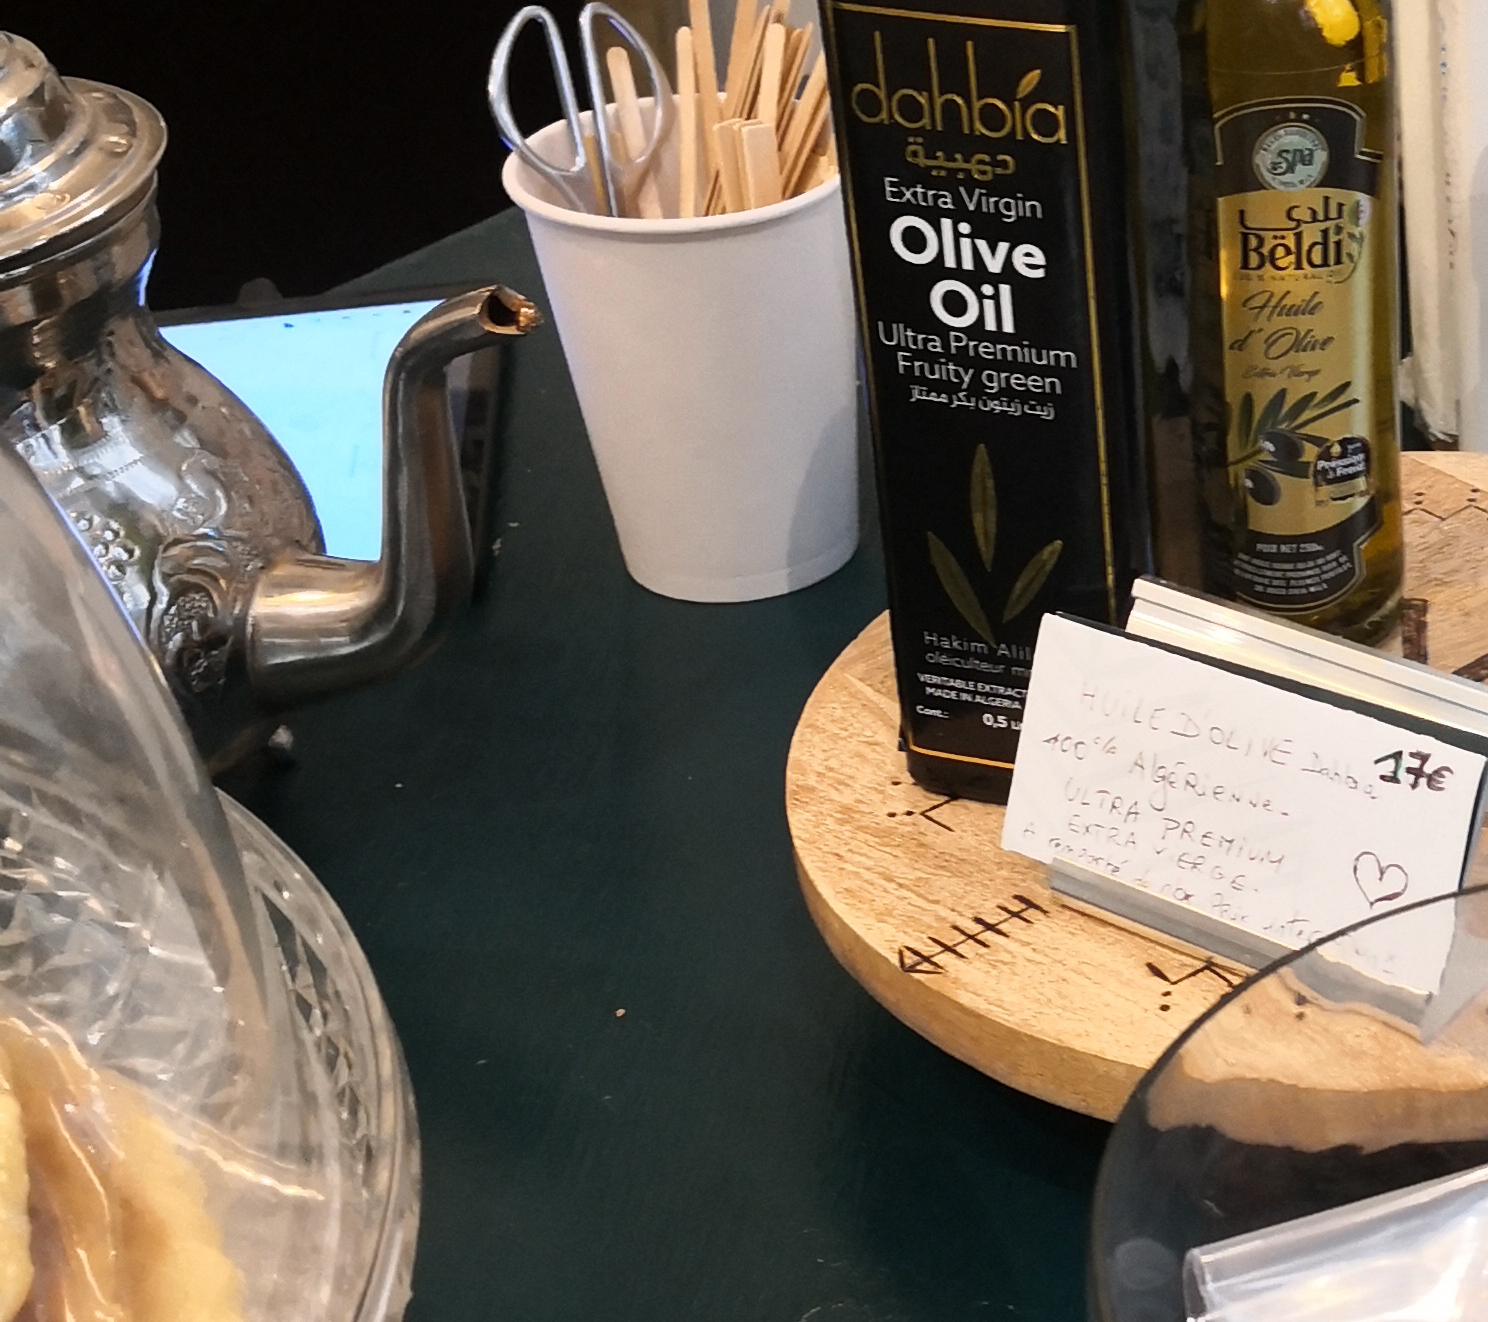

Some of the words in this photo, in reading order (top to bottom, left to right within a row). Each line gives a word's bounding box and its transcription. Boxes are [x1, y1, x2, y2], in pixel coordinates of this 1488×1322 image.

[884, 176, 957, 210] Extra
[958, 185, 1043, 223] Virgin
[889, 215, 1048, 279] Olive
[1238, 223, 1344, 272] Bëldi
[929, 279, 1017, 334] Oil
[1242, 290, 1324, 322] Huile
[877, 320, 945, 354] Ultra
[949, 331, 1078, 369] Premium
[896, 351, 975, 390] Fruity
[981, 369, 1063, 395] green
[923, 630, 989, 655] Hakim
[996, 643, 1033, 661] Alil
[925, 686, 960, 700] MADE
[982, 712, 1009, 729] 0,5
[1373, 749, 1455, 792] 17€
[1065, 776, 1141, 823] ULTRA
